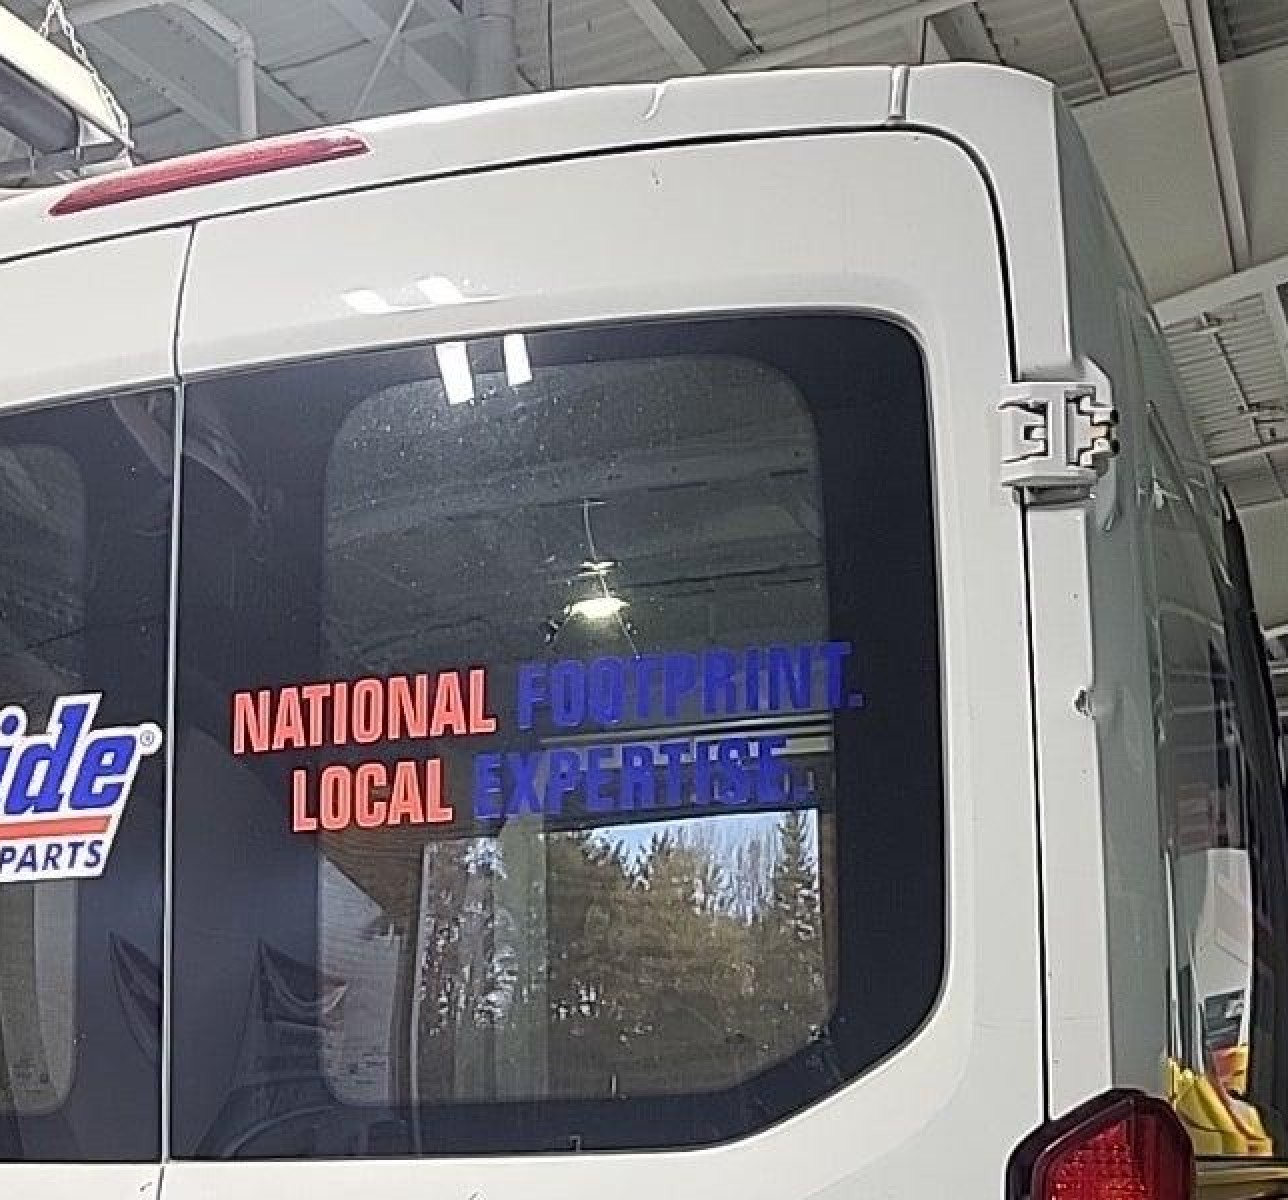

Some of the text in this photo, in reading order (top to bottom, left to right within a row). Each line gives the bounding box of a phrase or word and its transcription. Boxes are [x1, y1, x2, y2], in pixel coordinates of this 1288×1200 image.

[231, 641, 863, 755] NATIONAL FOOTPRINT.
[292, 758, 453, 832] LOCAL
